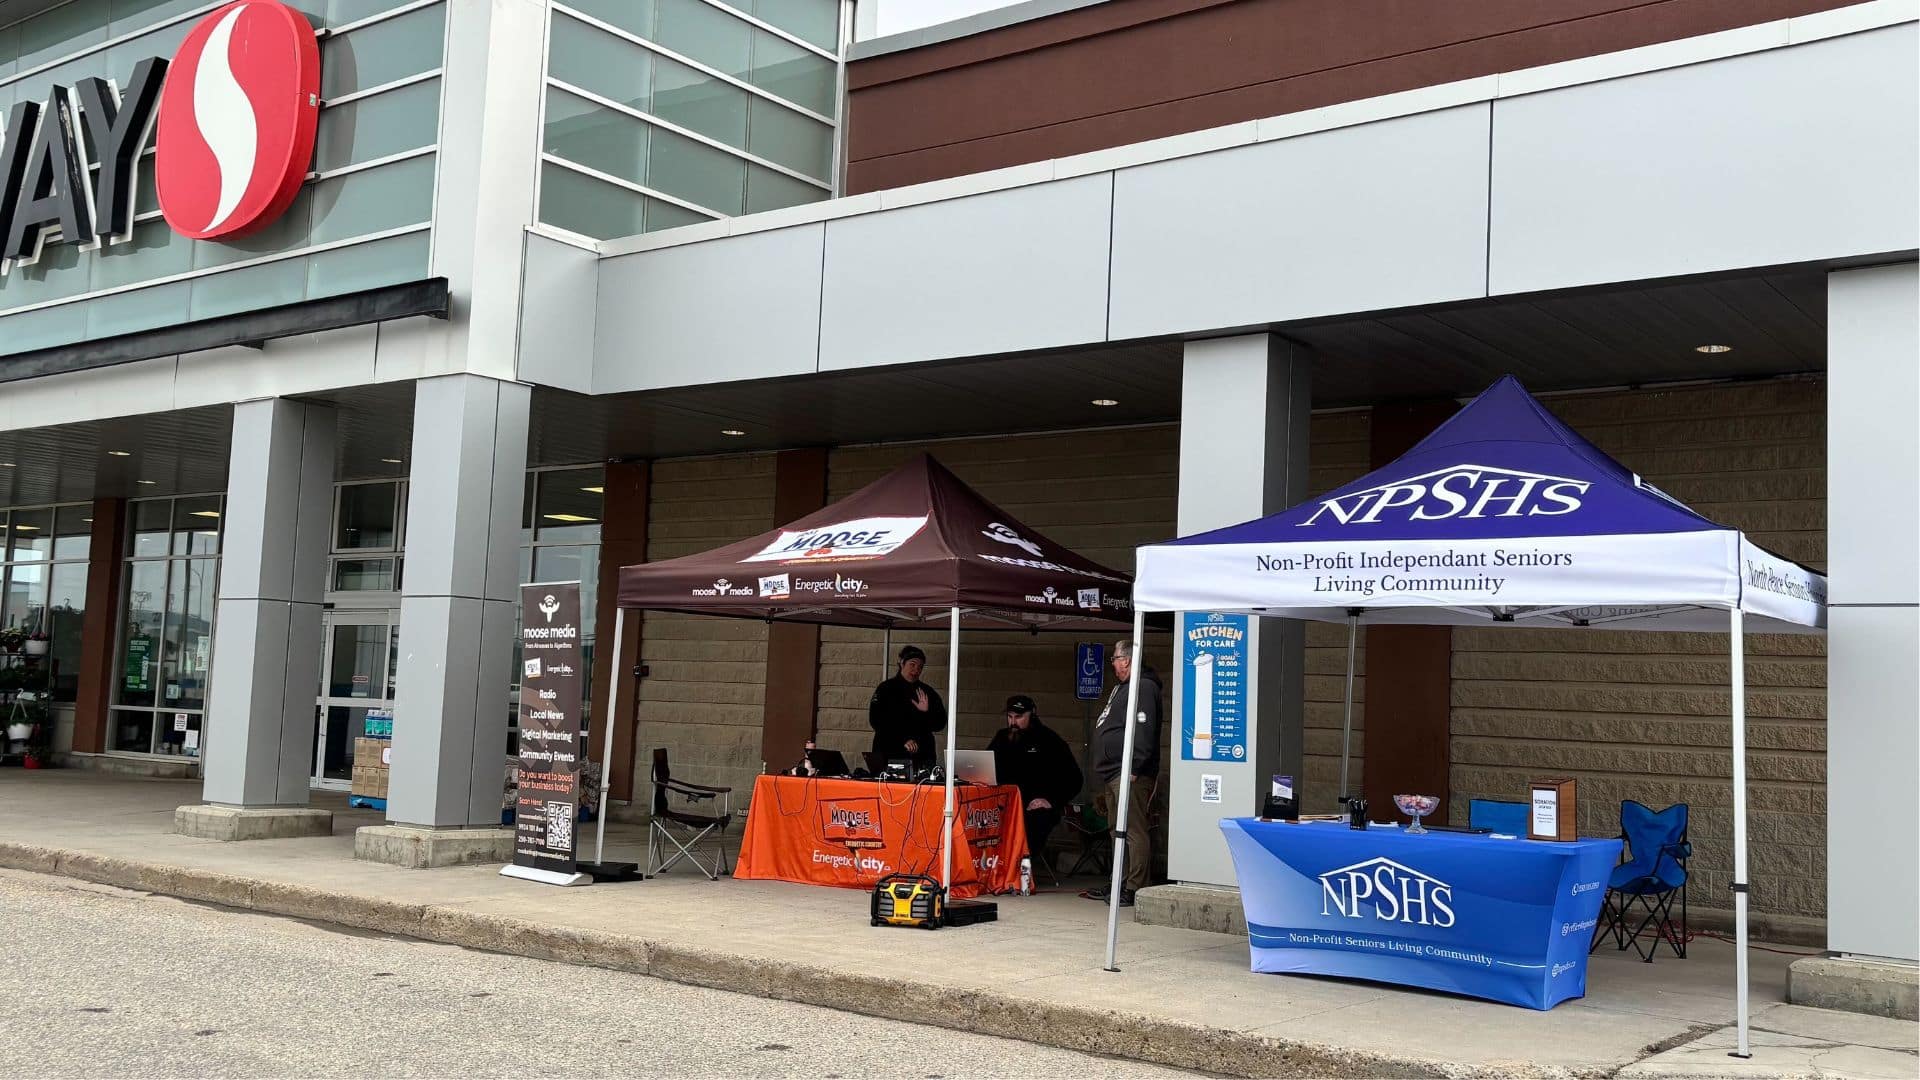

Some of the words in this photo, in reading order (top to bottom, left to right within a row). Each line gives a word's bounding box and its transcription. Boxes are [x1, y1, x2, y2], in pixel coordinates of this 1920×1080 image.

[1295, 470, 1592, 527] NPSHS
[783, 531, 891, 551] MOOSE
[1256, 552, 1354, 571] Non-Profit
[1360, 549, 1488, 573] Independant
[1493, 548, 1573, 568] Seniors
[1747, 559, 1768, 591] North
[692, 587, 717, 596] moose
[729, 585, 753, 596] media
[795, 578, 834, 593] Energetic
[1313, 576, 1377, 596] Living
[1380, 573, 1505, 595] Community
[1025, 594, 1046, 603] moose
[1055, 596, 1075, 606] media
[523, 626, 550, 639] moose
[550, 623, 576, 639] media
[1188, 626, 1243, 641] KITCHEN
[1196, 640, 1212, 648] FOR
[1213, 640, 1236, 648] CARE
[540, 689, 556, 700] Radio
[530, 709, 546, 720] Local
[547, 710, 564, 720] News
[521, 728, 542, 741] Digital
[542, 729, 573, 743] Marketing
[519, 748, 553, 763] Community
[553, 751, 575, 763] Events
[526, 772, 537, 781] you
[538, 772, 550, 780] want
[551, 772, 557, 780] to
[557, 773, 574, 783] boost
[518, 780, 531, 790] your
[531, 781, 554, 791] business
[554, 782, 573, 794] today?
[831, 808, 870, 826] MOOSE
[812, 850, 853, 868] Energetic
[1318, 866, 1455, 933] NPSHS
[1289, 933, 1342, 945] Non-Profit
[1345, 936, 1386, 949] Seniors
[1388, 940, 1422, 955] Living
[1425, 945, 1493, 967] Community
